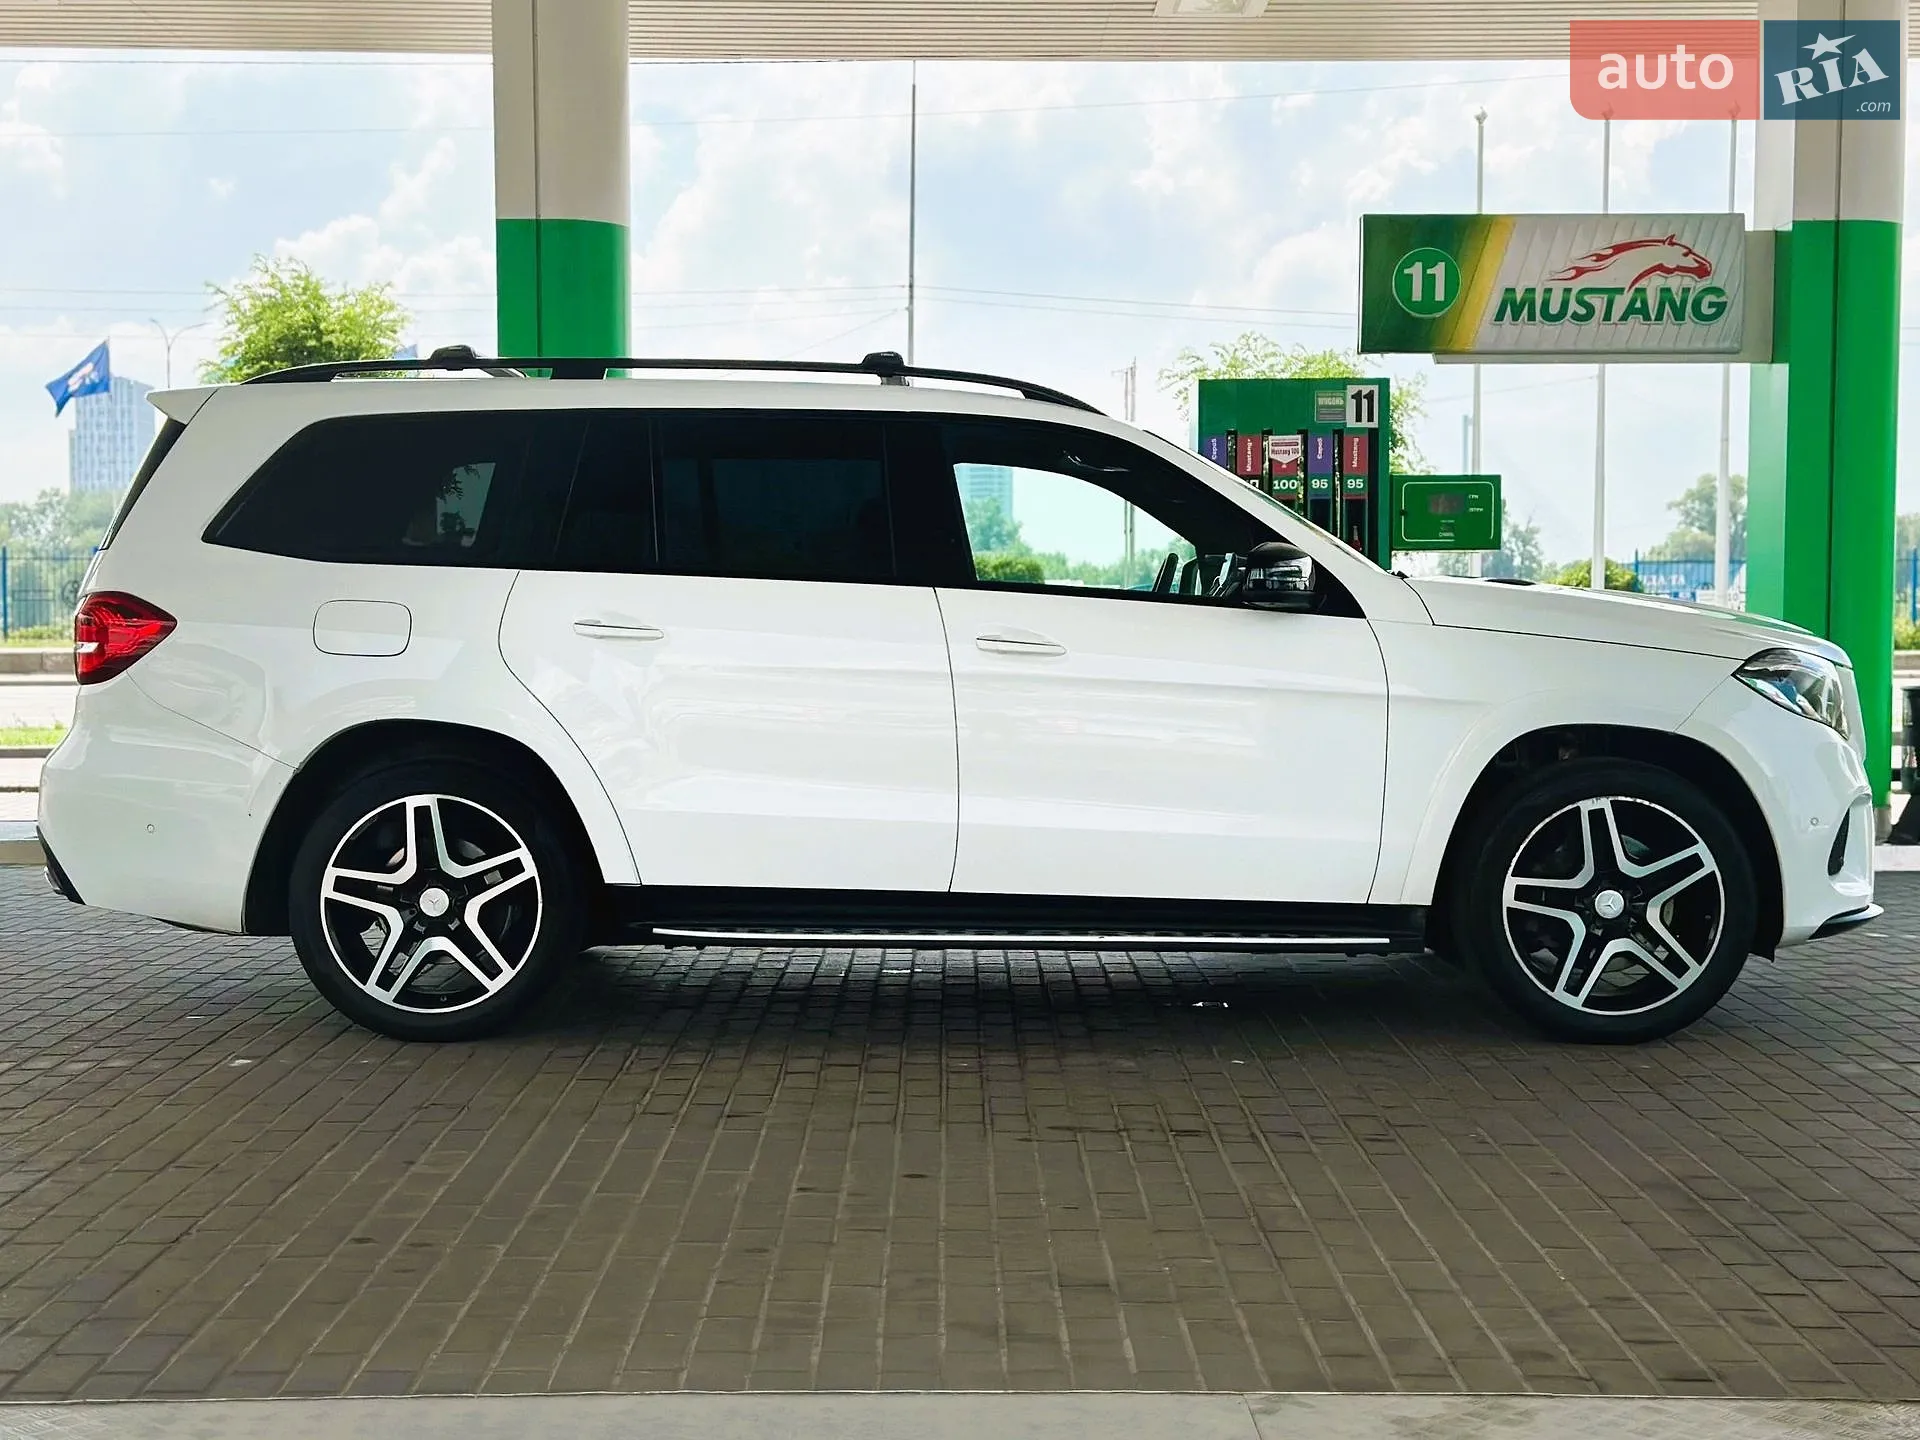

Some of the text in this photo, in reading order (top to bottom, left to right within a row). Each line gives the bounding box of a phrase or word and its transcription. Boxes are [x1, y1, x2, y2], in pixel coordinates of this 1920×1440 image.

[1403, 261, 1446, 302] 11
[1493, 286, 1729, 324] MUSTANG
[1351, 389, 1375, 423] 11
[1273, 480, 1298, 490] 100
[1311, 479, 1329, 489] 95
[1347, 479, 1364, 489] 95
